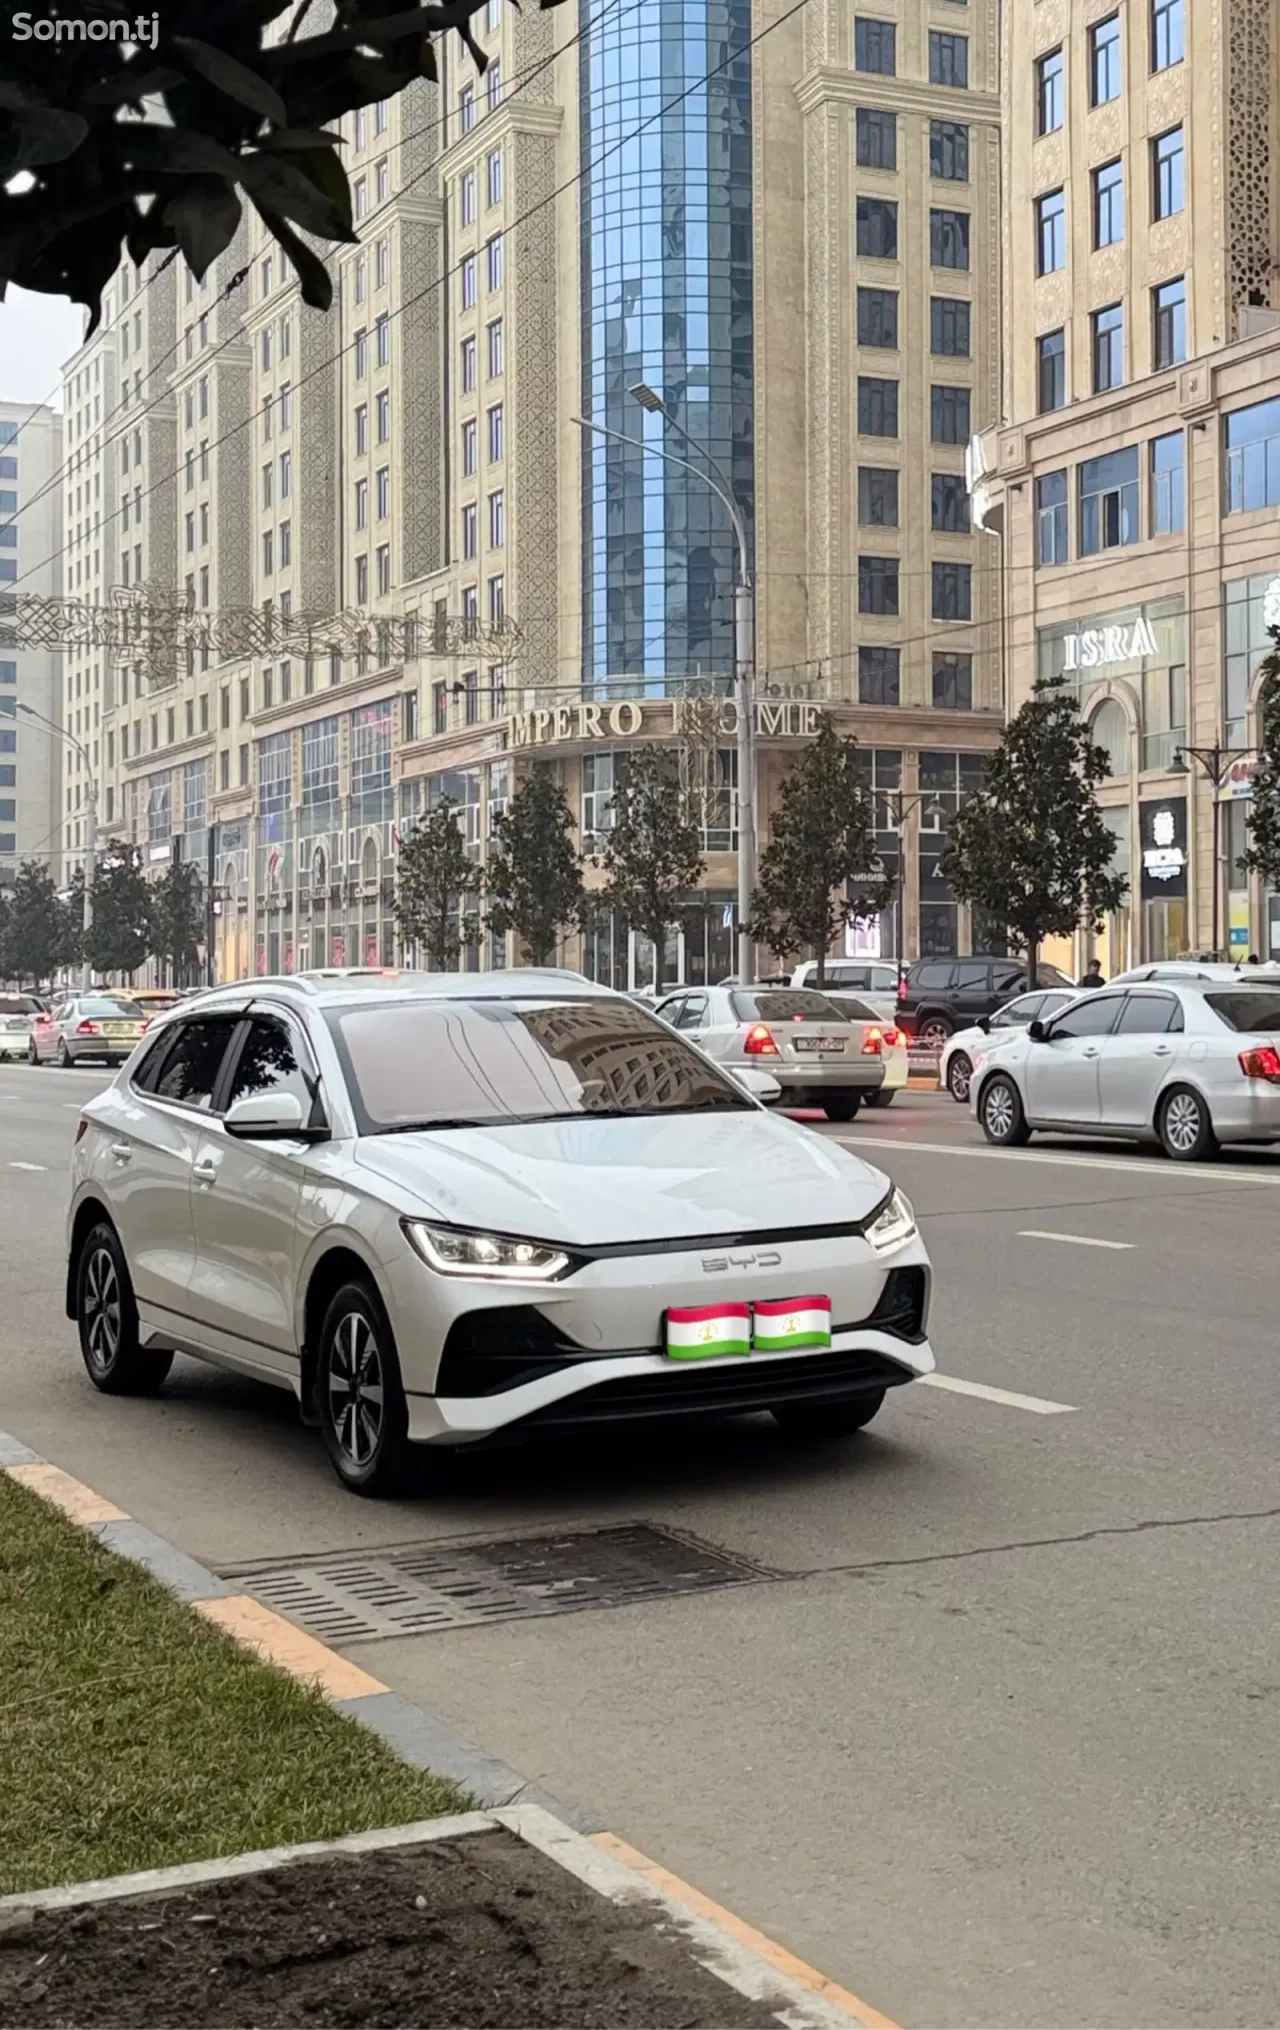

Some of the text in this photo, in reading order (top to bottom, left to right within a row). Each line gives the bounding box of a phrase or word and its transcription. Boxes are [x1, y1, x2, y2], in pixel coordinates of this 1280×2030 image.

[1062, 616, 1159, 671] ISRA
[506, 701, 643, 747] IMPERO
[701, 1251, 782, 1273] BYD
